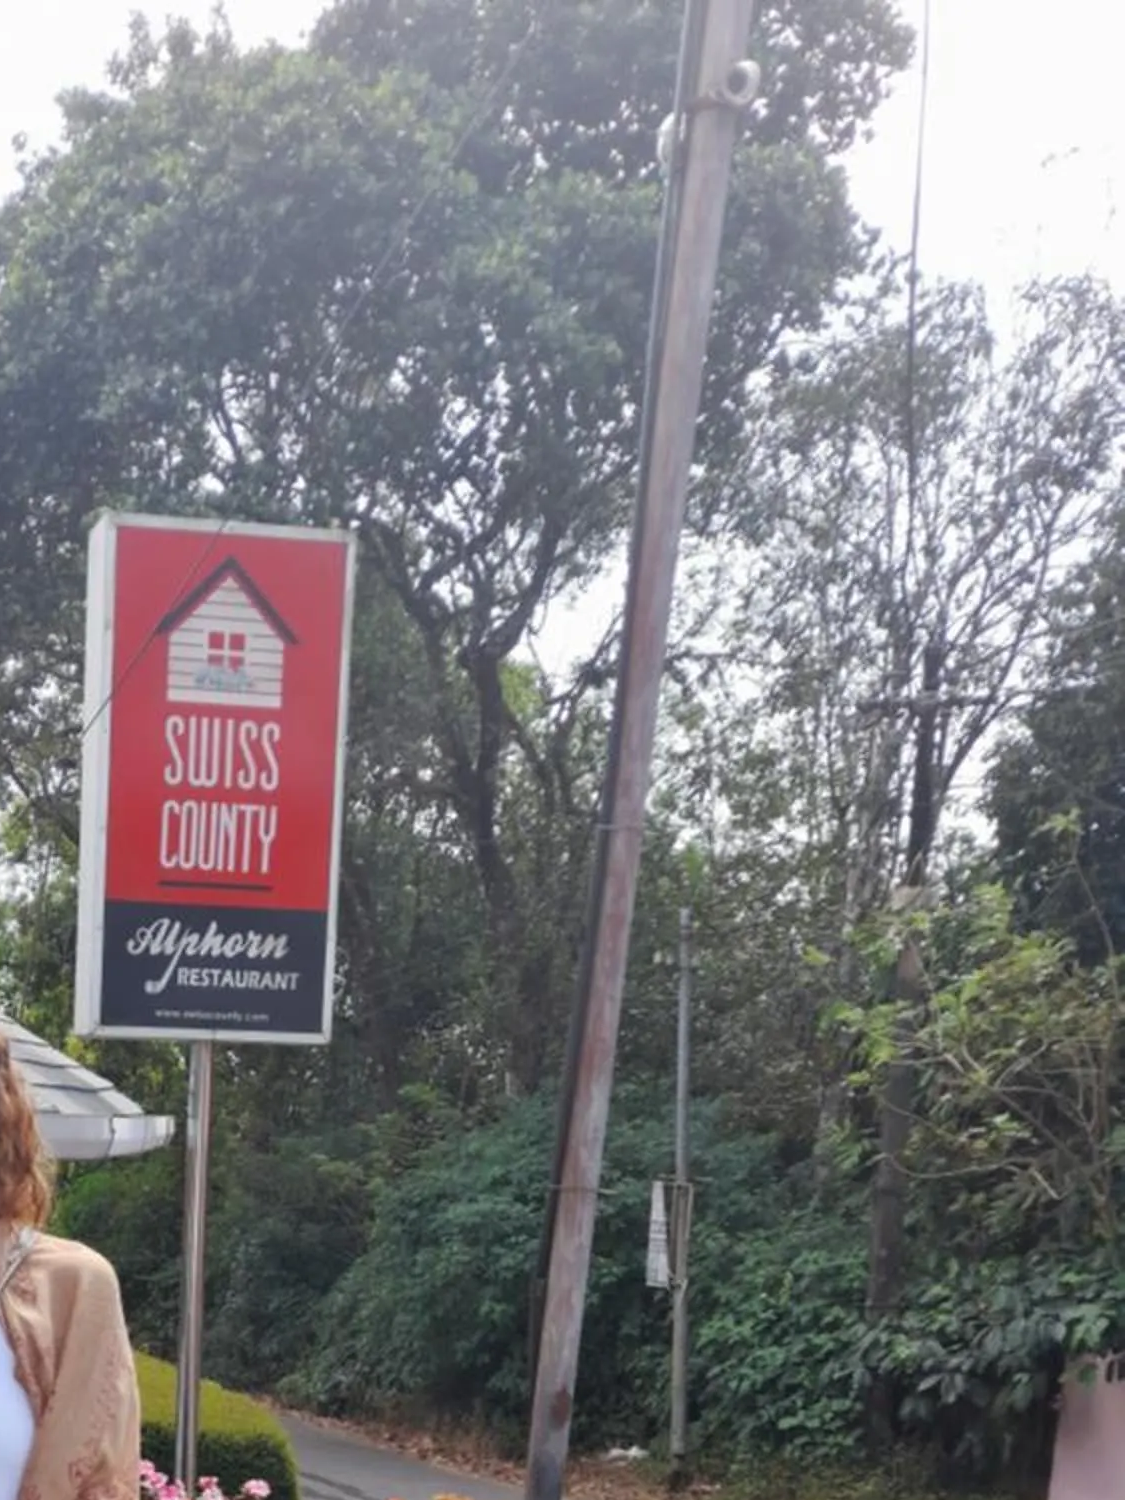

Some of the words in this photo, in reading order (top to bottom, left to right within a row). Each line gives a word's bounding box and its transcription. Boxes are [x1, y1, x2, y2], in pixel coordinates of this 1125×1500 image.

[164, 715, 280, 790] SWISS
[159, 799, 277, 874] COUNTY
[126, 917, 289, 994] Alphorn
[177, 967, 300, 991] RESTAURANT
